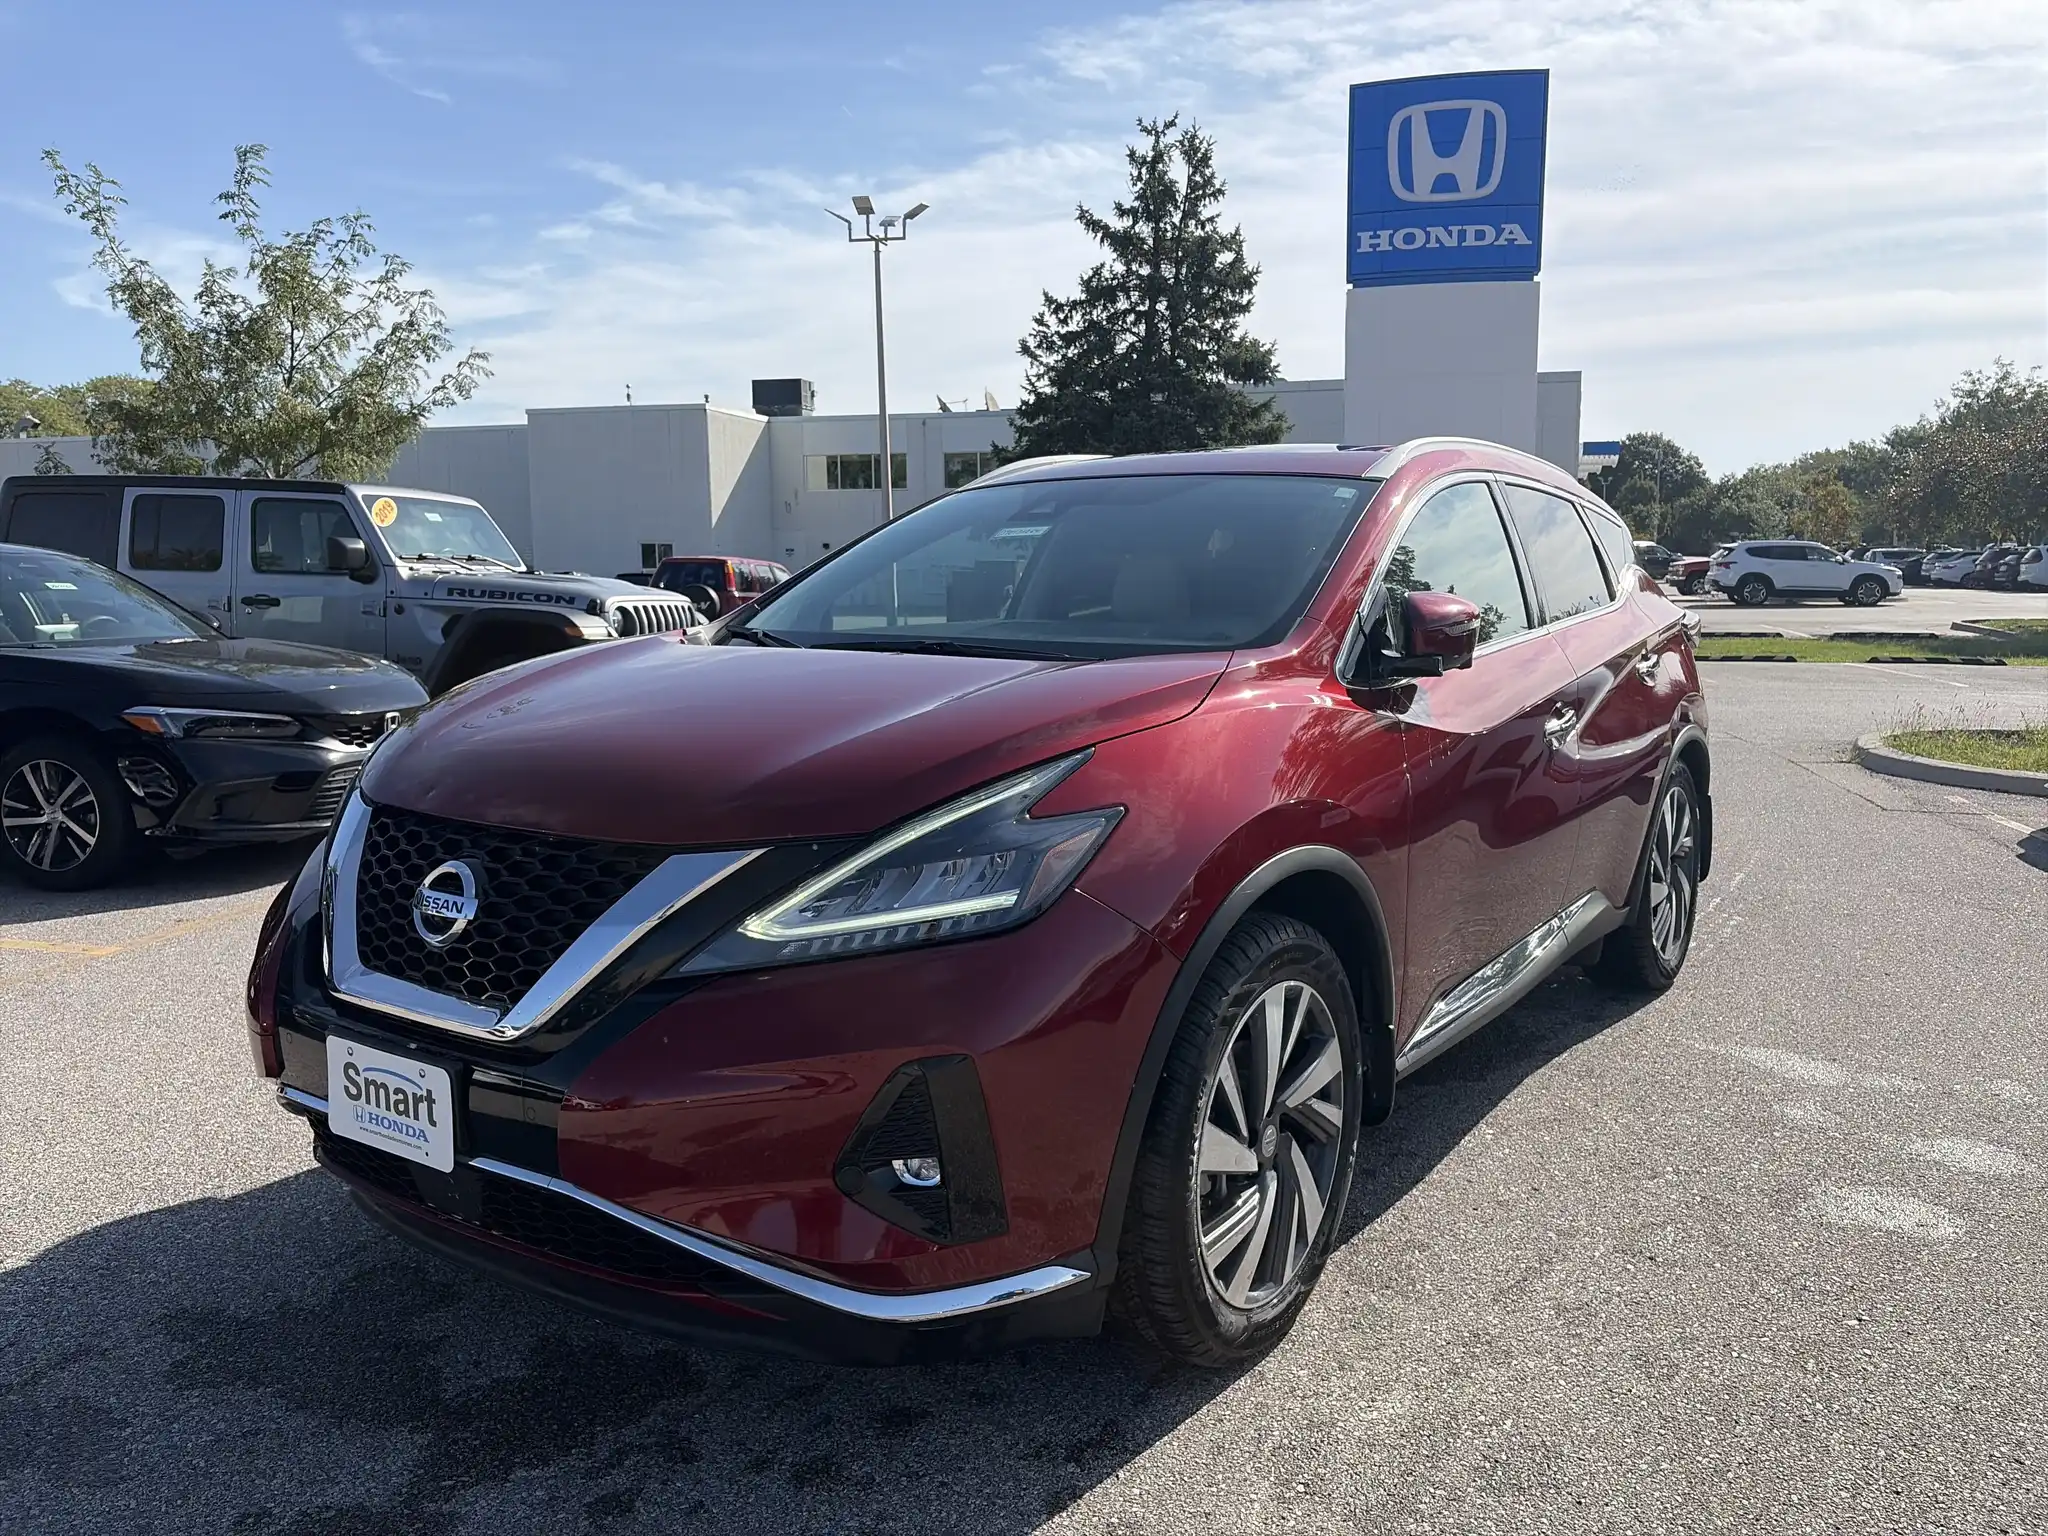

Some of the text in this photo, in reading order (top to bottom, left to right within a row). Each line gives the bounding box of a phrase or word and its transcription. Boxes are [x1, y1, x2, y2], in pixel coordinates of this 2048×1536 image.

[1357, 223, 1532, 253] HONDA
[375, 500, 394, 525] 2019
[447, 587, 576, 605] RUBICON
[343, 1061, 437, 1128] Smart
[368, 1111, 430, 1143] HONDA
